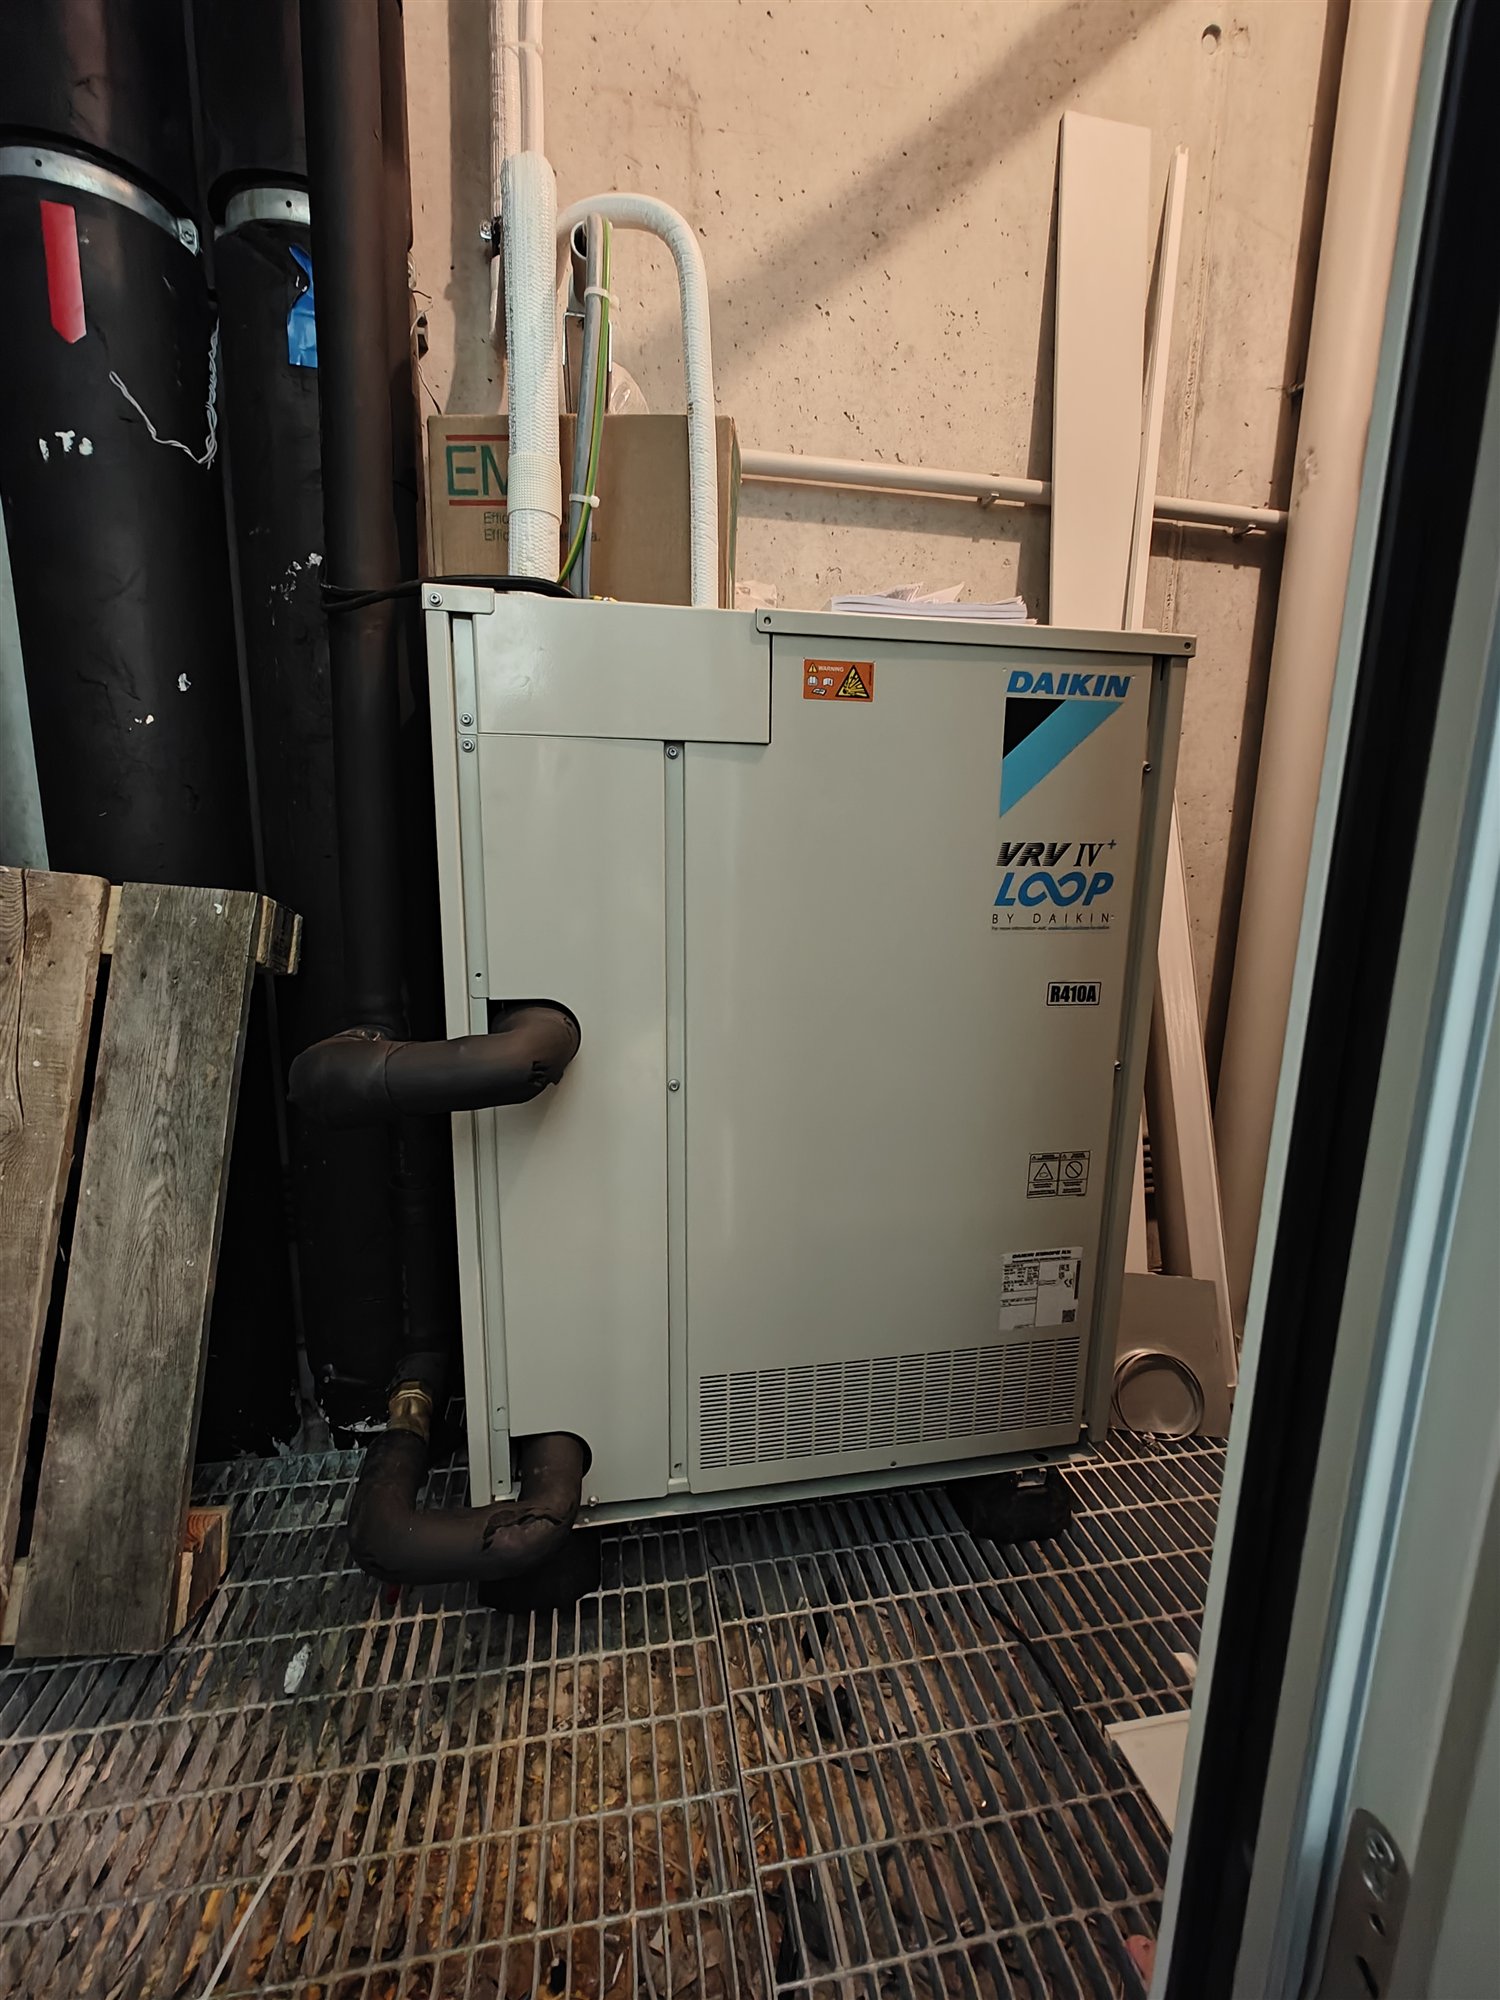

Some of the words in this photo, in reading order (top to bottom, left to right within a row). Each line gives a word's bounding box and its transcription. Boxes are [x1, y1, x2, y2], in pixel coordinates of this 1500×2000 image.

[818, 665, 844, 673] WARNING
[1006, 670, 1131, 698] DAIKIN
[996, 842, 1072, 867] VRV
[993, 871, 1114, 907] LOOP
[991, 913, 1014, 925] BY
[1032, 912, 1110, 924] DAIKIN
[1050, 984, 1097, 1003] R410A
